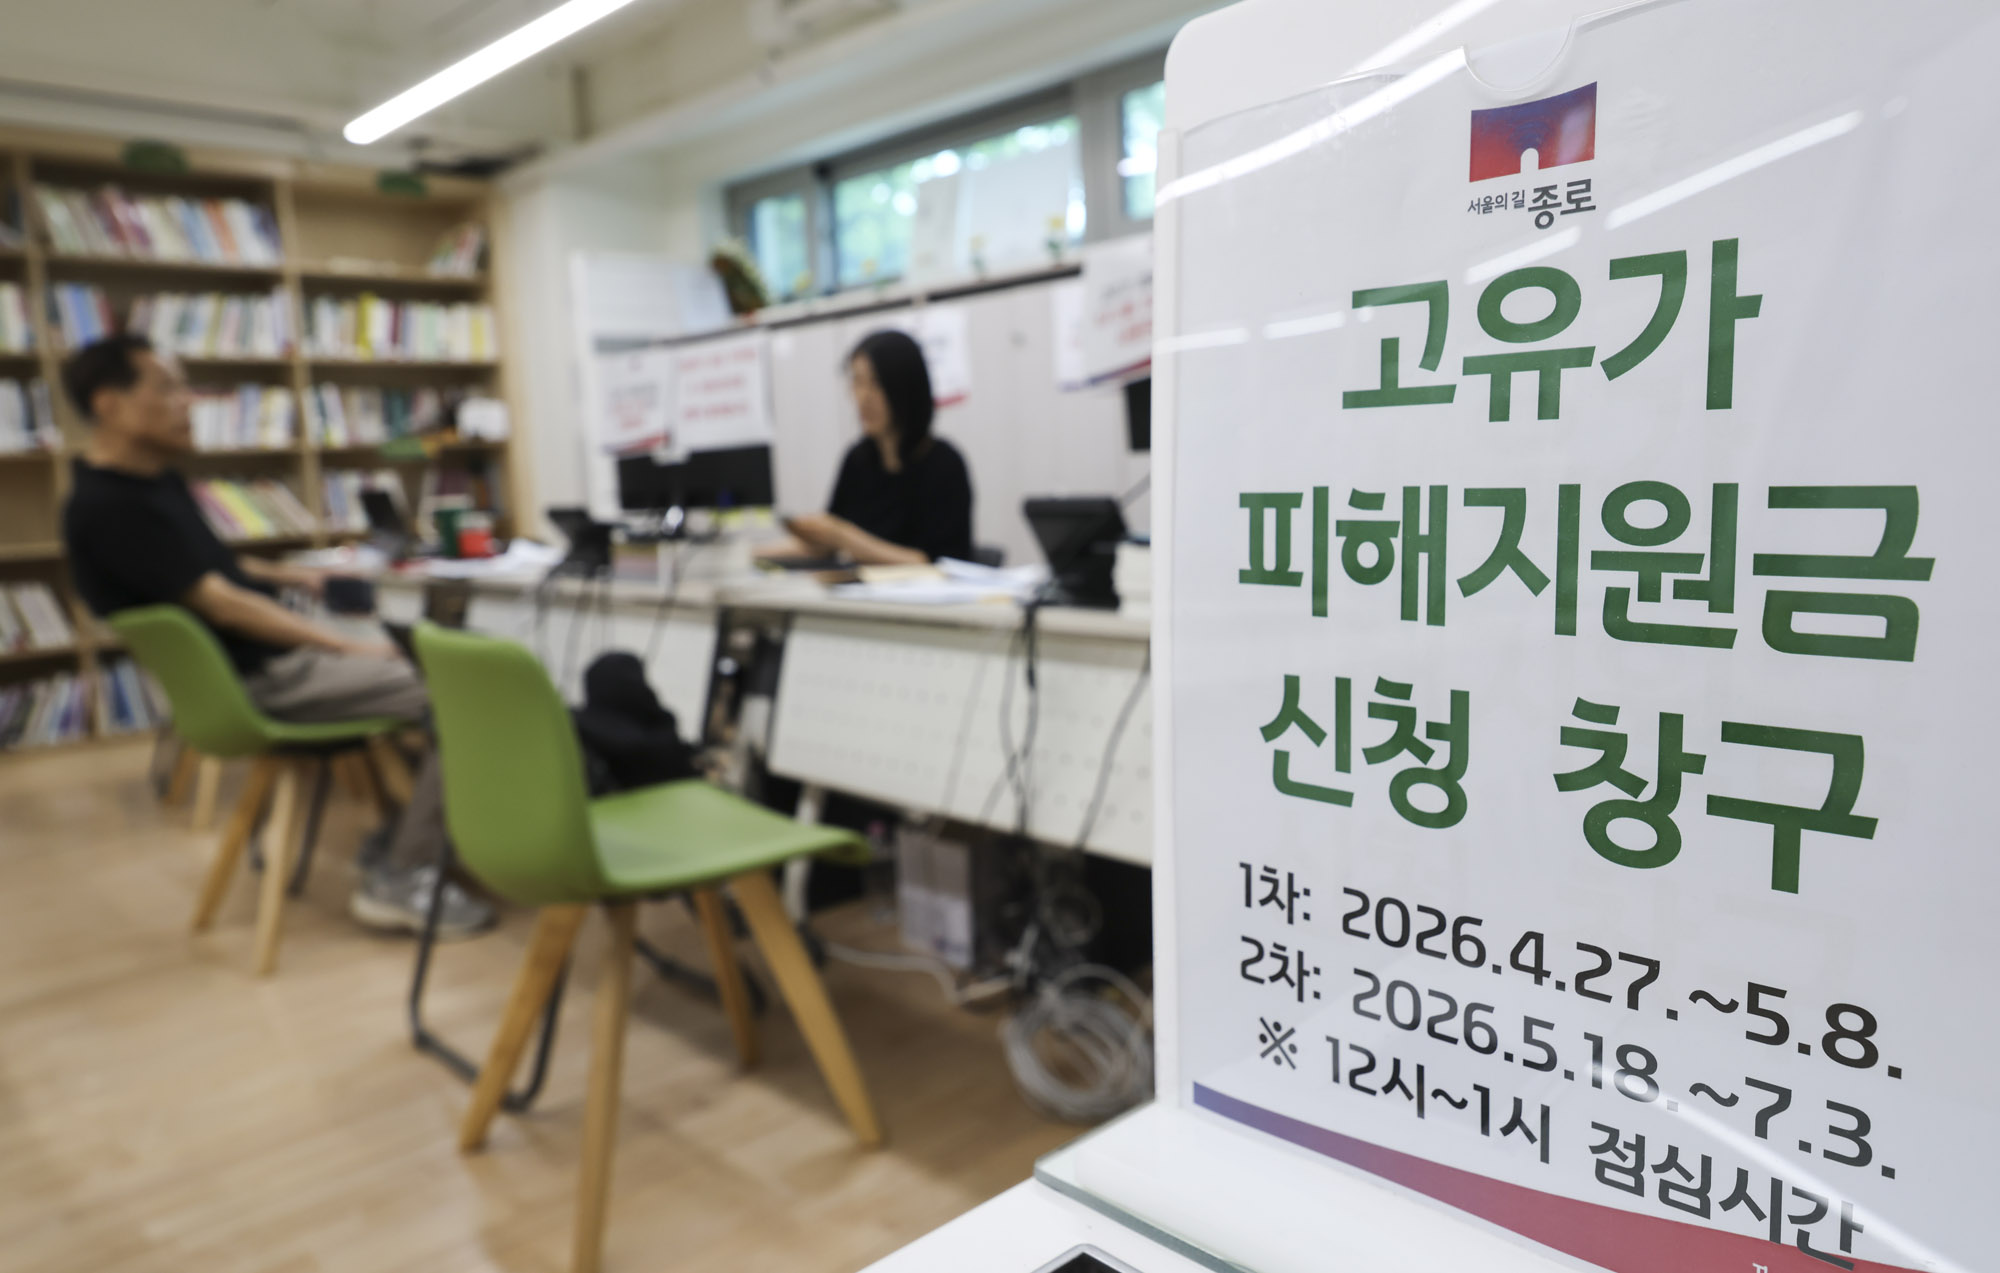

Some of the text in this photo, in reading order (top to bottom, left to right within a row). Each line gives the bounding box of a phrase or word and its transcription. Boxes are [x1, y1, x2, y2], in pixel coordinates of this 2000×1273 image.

[1467, 178, 1597, 230] 서울의 길 종로
[1342, 237, 1763, 423] 고유가
[1238, 480, 1936, 663] 피해지원금
[1259, 673, 1879, 895] 신청 창구
[1239, 862, 1904, 1079] 1차: 2026.4.27.~5.8.
[1239, 936, 1897, 1181] 2차: 2026.5.18.~7.3.
[1326, 1036, 1551, 1164] 12시~1시
[1588, 1120, 1865, 1271] 점심시간
